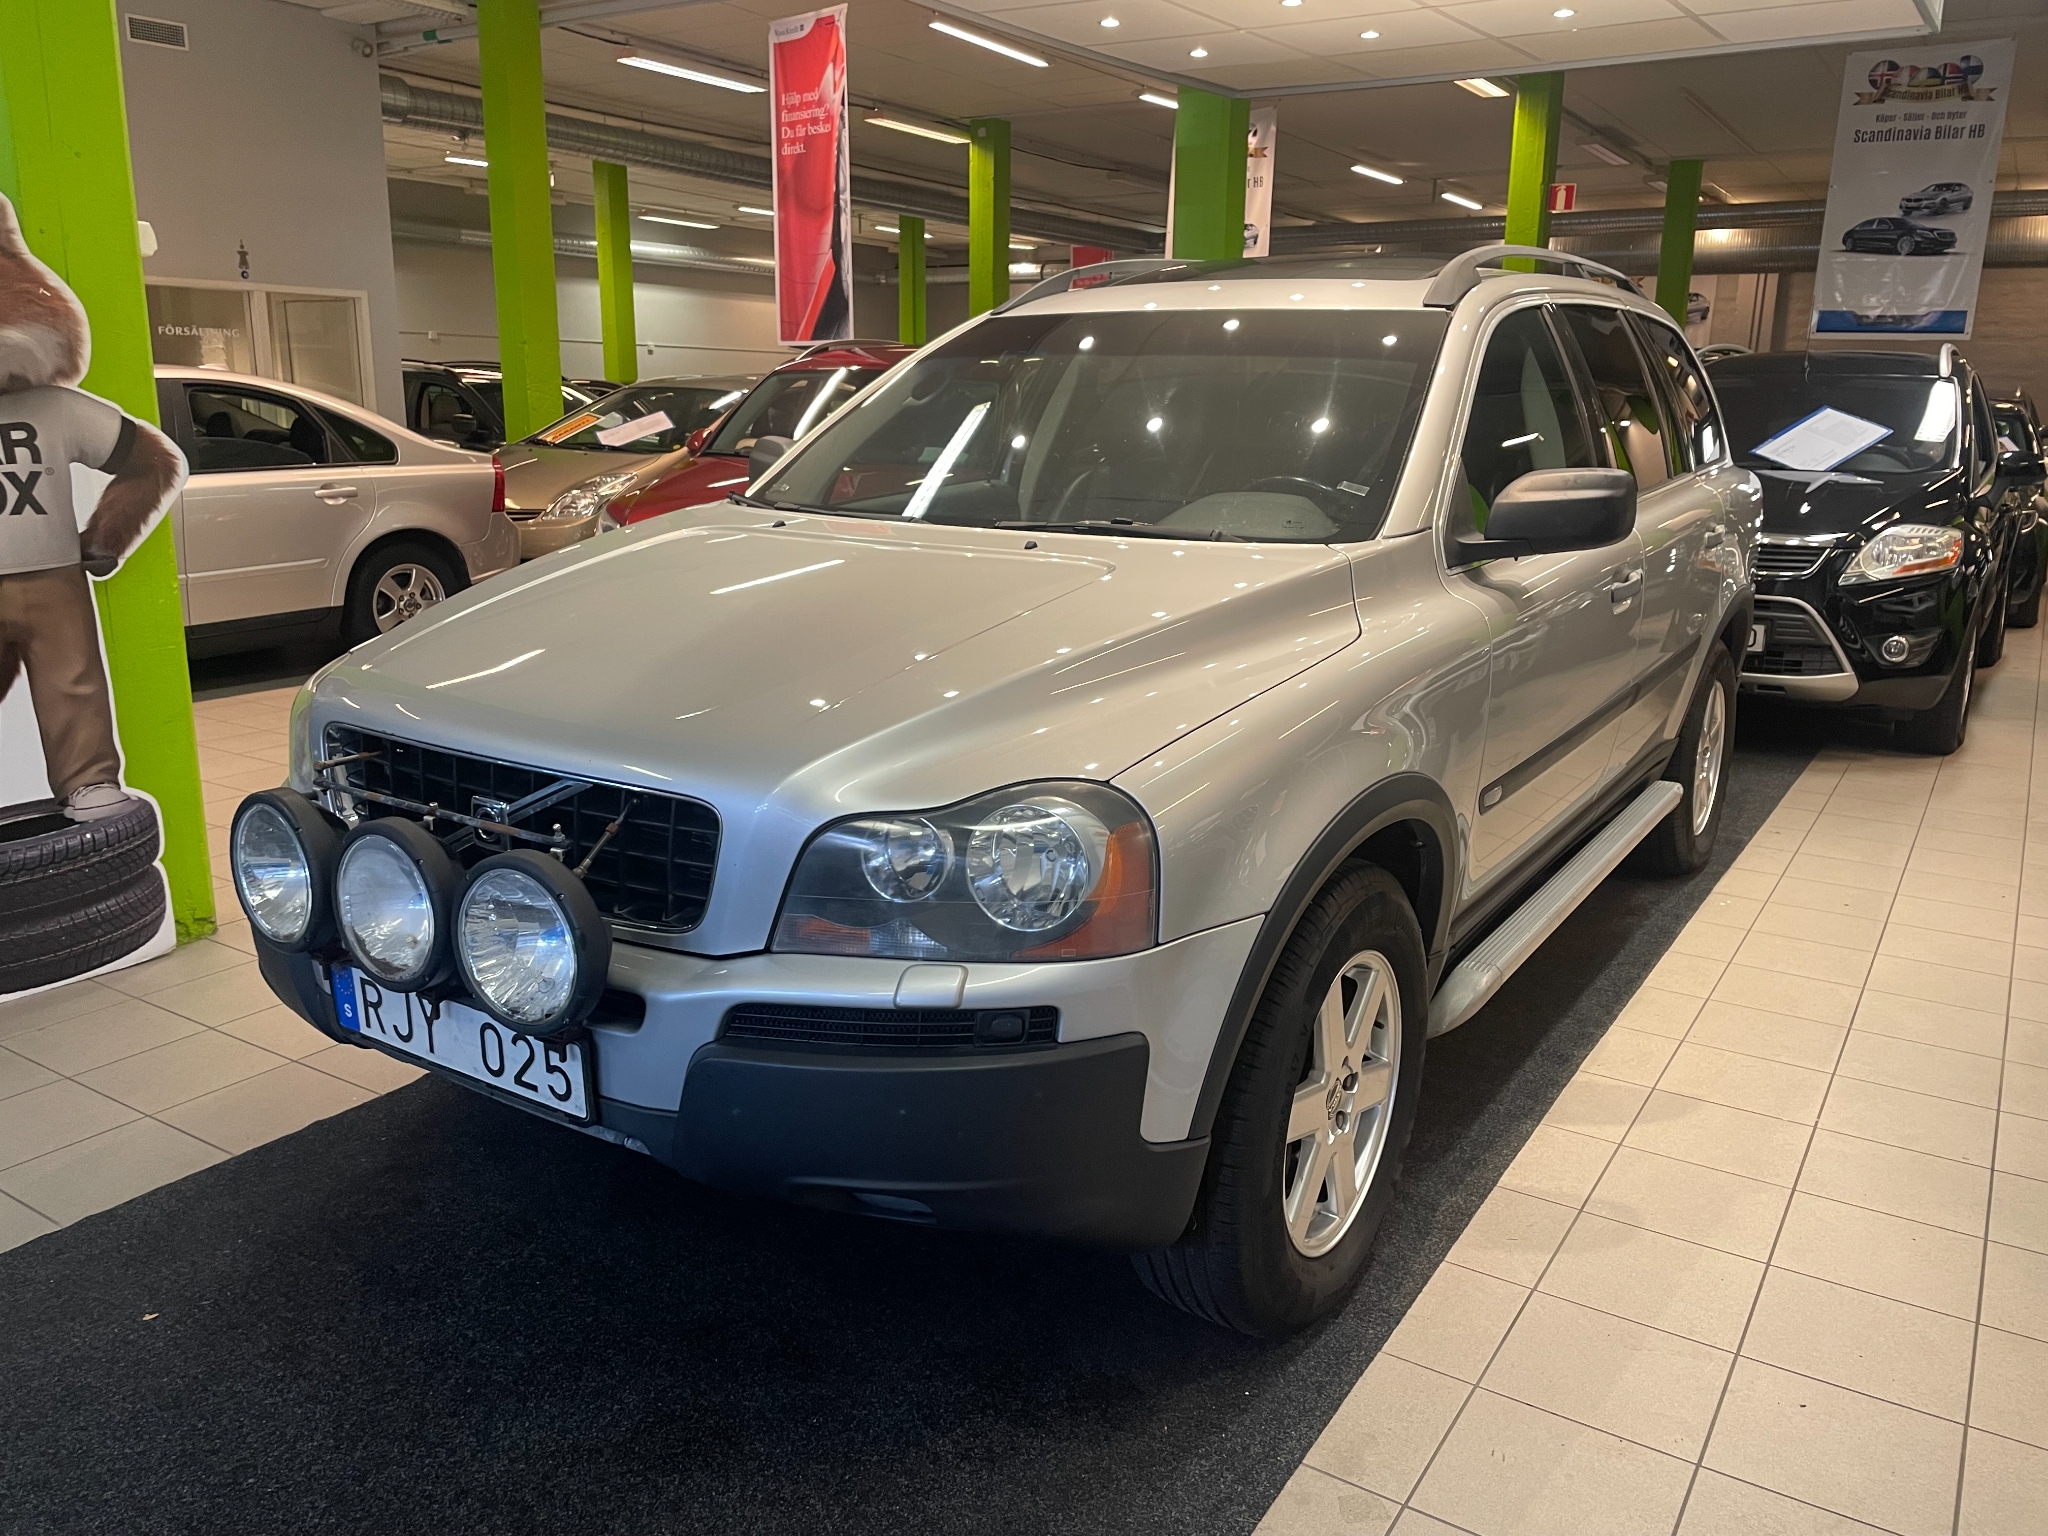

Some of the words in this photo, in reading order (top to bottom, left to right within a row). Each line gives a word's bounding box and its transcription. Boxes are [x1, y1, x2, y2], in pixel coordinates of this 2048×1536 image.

[802, 87, 819, 102] med
[782, 103, 829, 122] finansiering?
[1854, 126, 1932, 143] Scandinavia
[1935, 125, 1966, 140] Bilar
[1969, 124, 1985, 138] HB
[158, 323, 240, 338] FÖRSÄLING
[0, 421, 43, 465] R
[0, 470, 49, 516] X
[344, 1003, 353, 1018] S
[359, 976, 439, 1055] RJY
[479, 1021, 572, 1102] 025
